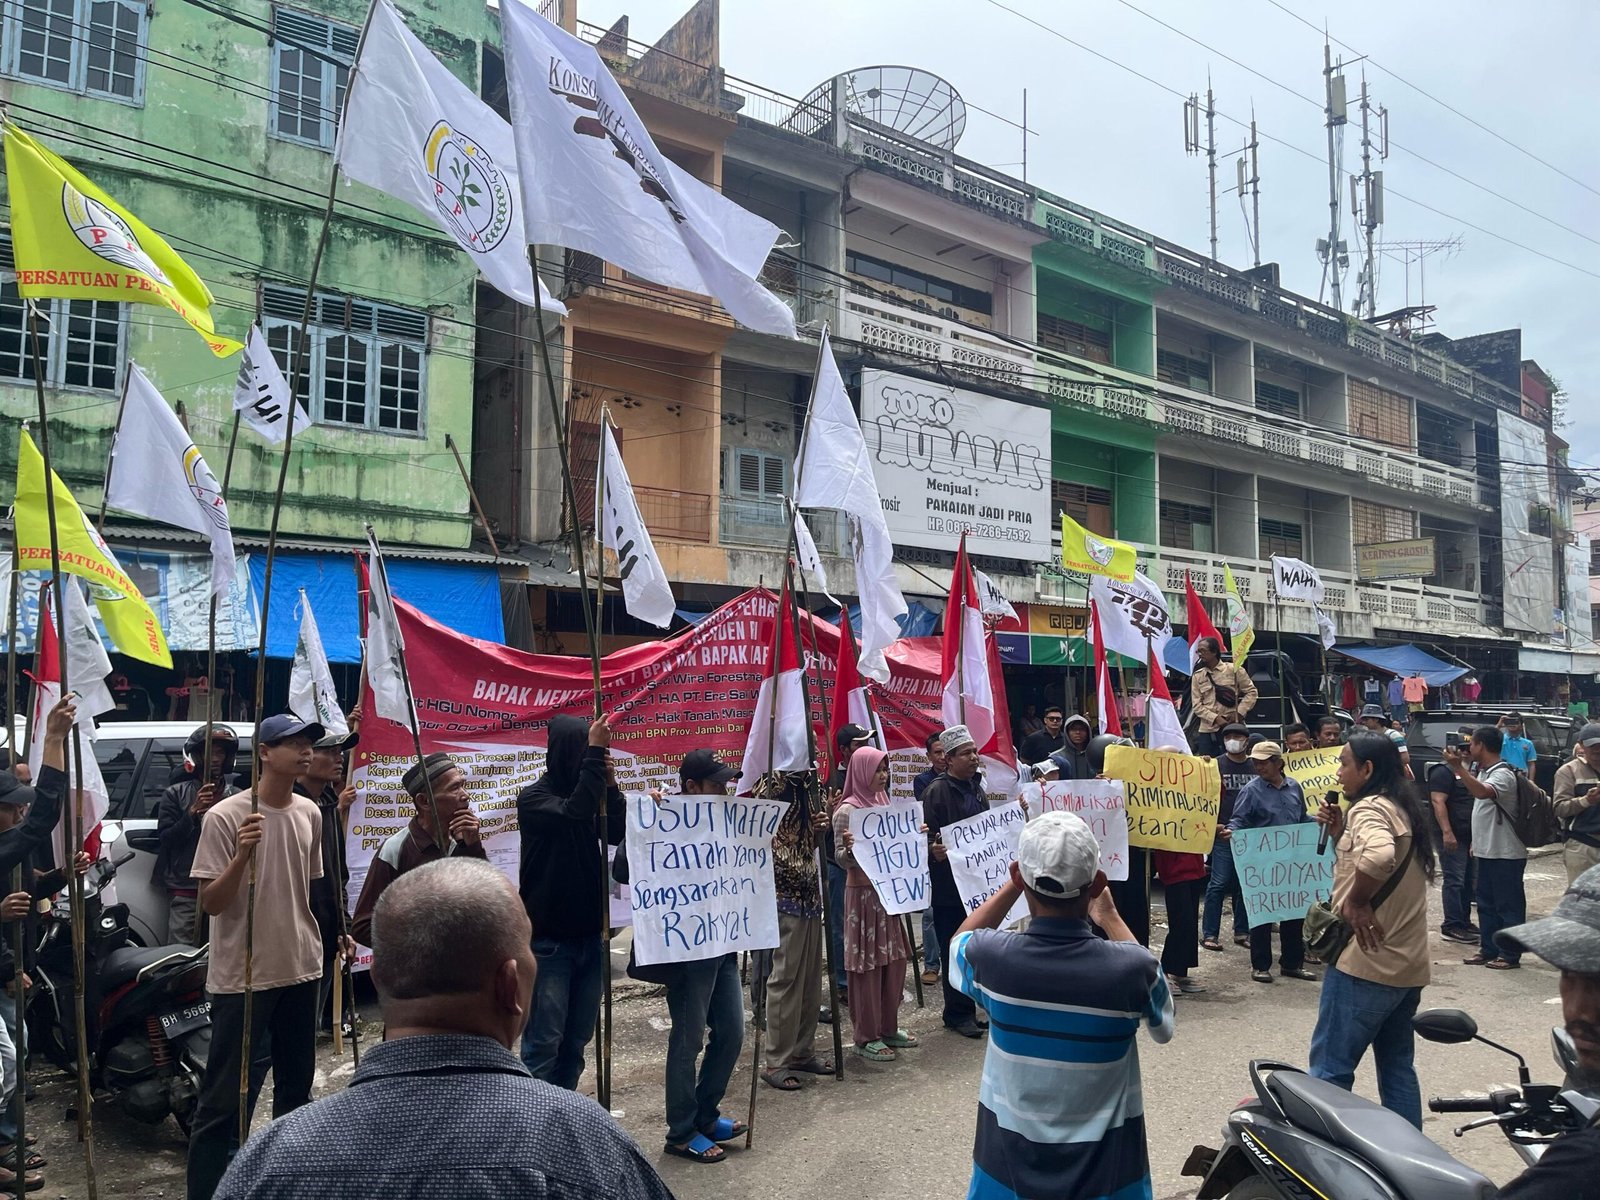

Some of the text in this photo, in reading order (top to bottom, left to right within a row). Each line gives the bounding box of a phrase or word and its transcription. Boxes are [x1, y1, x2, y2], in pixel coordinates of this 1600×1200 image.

[16, 269, 119, 288] PERSATUAN
[881, 386, 954, 425] TOKO
[926, 477, 972, 496] Menjual
[926, 497, 975, 516] PAKAIAN
[978, 505, 1004, 520] JADI
[1008, 509, 1032, 524] PRIA
[927, 516, 944, 532] HP.
[473, 679, 532, 707] BAPAK
[701, 644, 748, 667] BAPAK
[426, 698, 462, 715] HGU
[465, 704, 517, 722] Nomor
[655, 711, 681, 724] Hak
[683, 710, 720, 722] Tanah
[646, 728, 668, 738] BPN
[670, 727, 692, 737] Prov.
[695, 725, 725, 735] Jambi
[727, 723, 745, 732] Dan
[369, 751, 408, 766] Segera
[449, 754, 474, 764] Dan
[475, 752, 516, 764] Proses
[517, 750, 548, 761] Huku
[613, 757, 633, 768] ang
[635, 755, 660, 765] Telah
[662, 752, 688, 763] Turut
[463, 780, 498, 790] antan
[500, 772, 537, 788] Kades
[470, 765, 515, 777] Tanjung
[639, 766, 669, 777] Jambi
[1139, 753, 1194, 793] STOP
[366, 793, 394, 804] Kec.
[365, 806, 396, 819] Desa
[637, 796, 717, 833] USUT
[862, 808, 922, 840] Cabut
[646, 840, 728, 873] Tanah
[871, 840, 920, 874] HGU
[661, 906, 752, 951] Rakyat
[161, 1013, 178, 1028] BH
[1240, 1131, 1274, 1166] Genio
